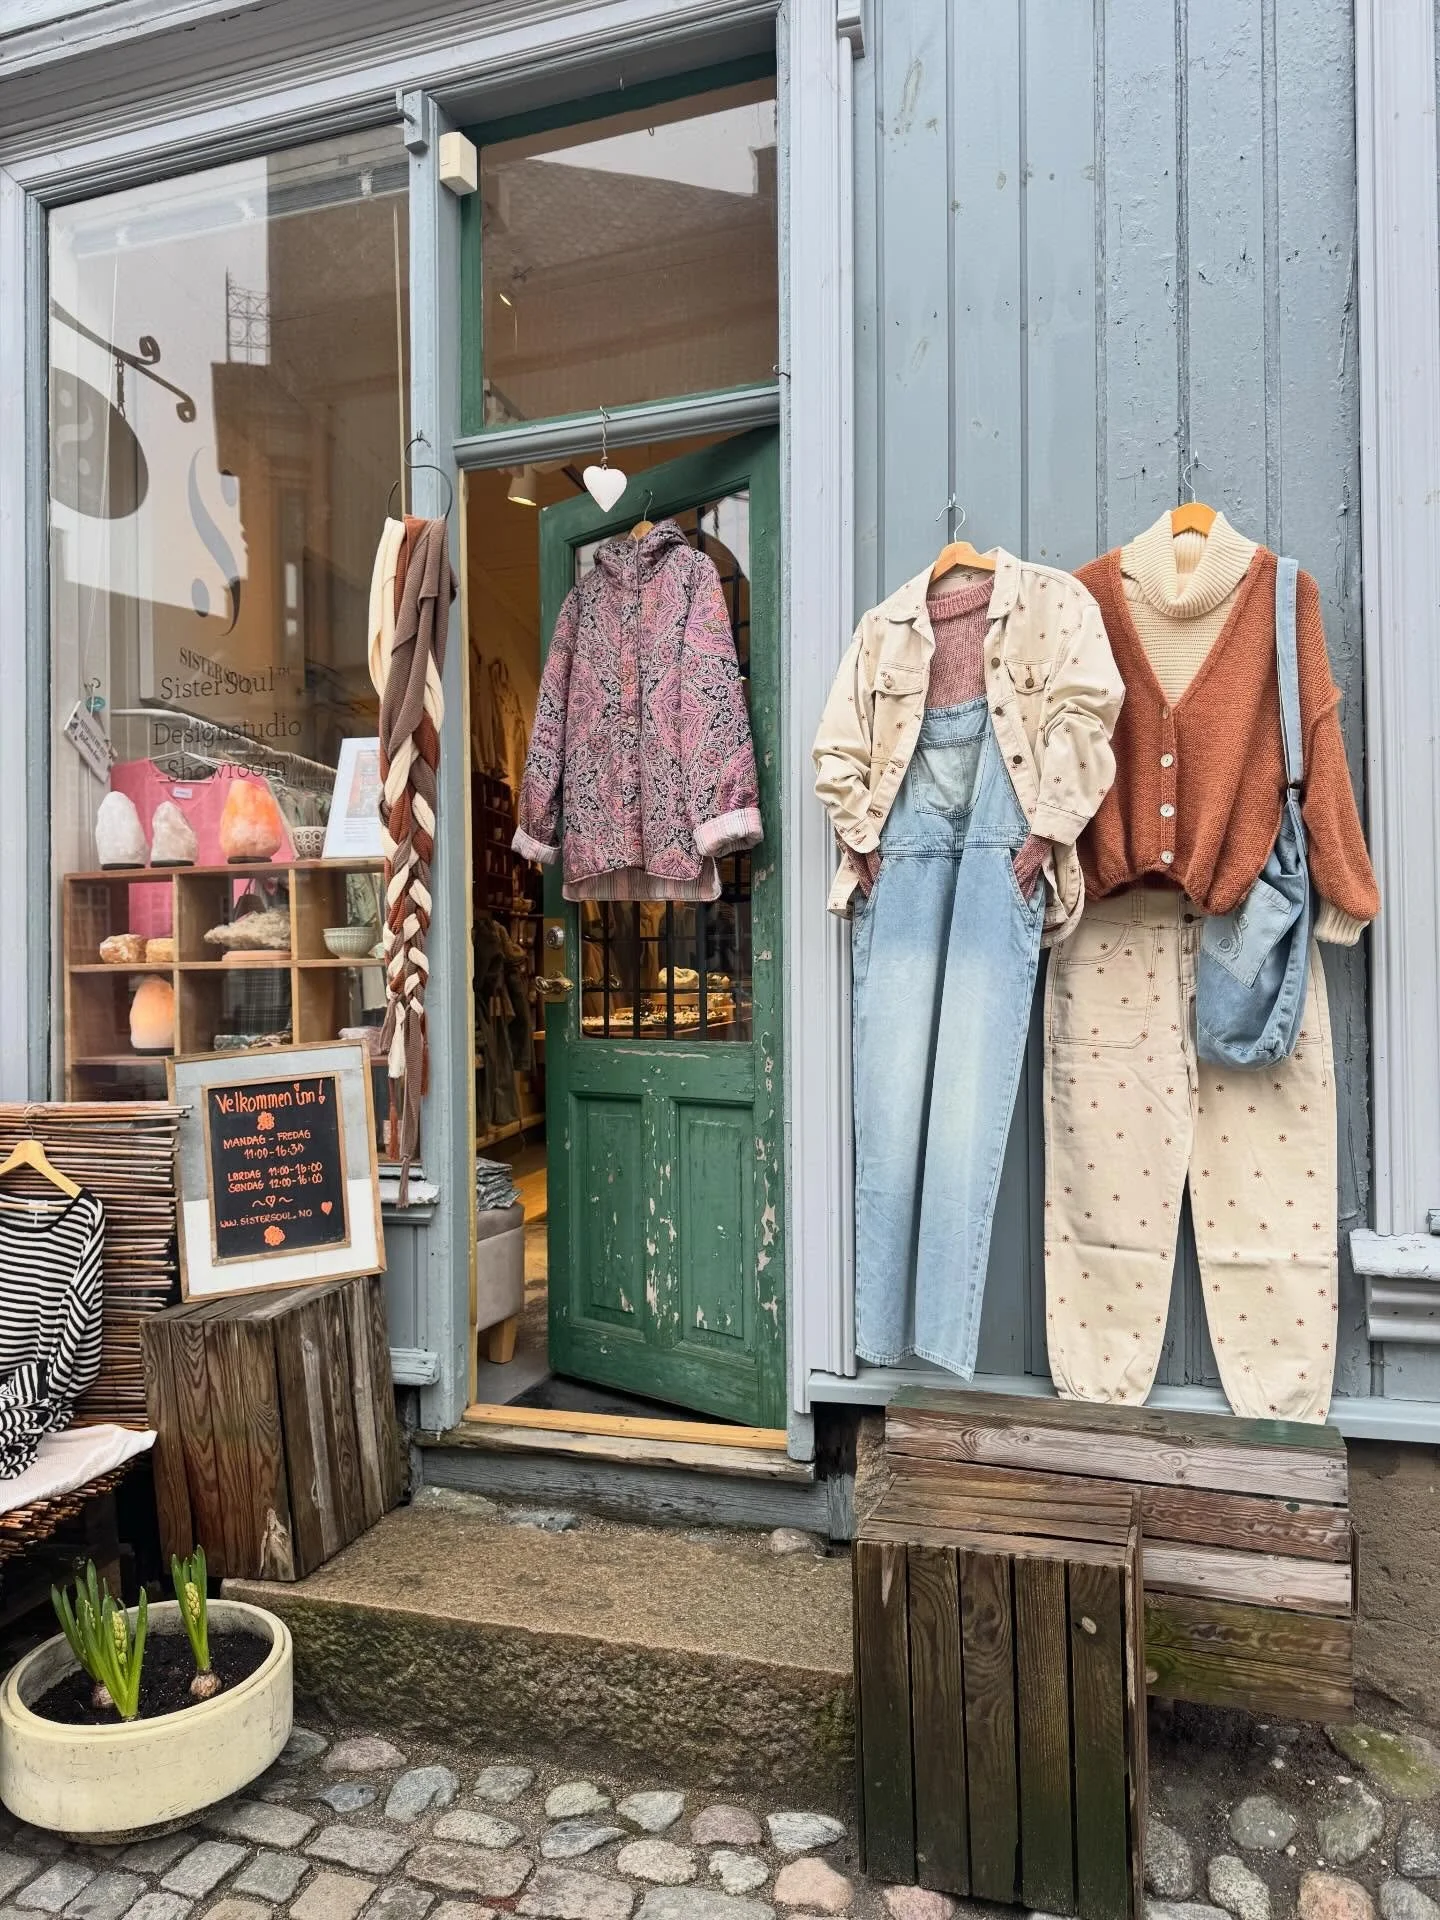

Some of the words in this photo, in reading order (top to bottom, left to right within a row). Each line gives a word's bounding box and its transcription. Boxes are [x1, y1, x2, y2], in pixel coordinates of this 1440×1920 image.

[153, 712, 301, 748] Designstudio
[168, 757, 288, 782] Showroom
[215, 1090, 292, 1114] Velkommen
[224, 1134, 266, 1149] MANDAG
[277, 1129, 311, 1142] FREDAG
[228, 1170, 261, 1182] LØRDAG
[228, 1180, 264, 1193] SØNDAG
